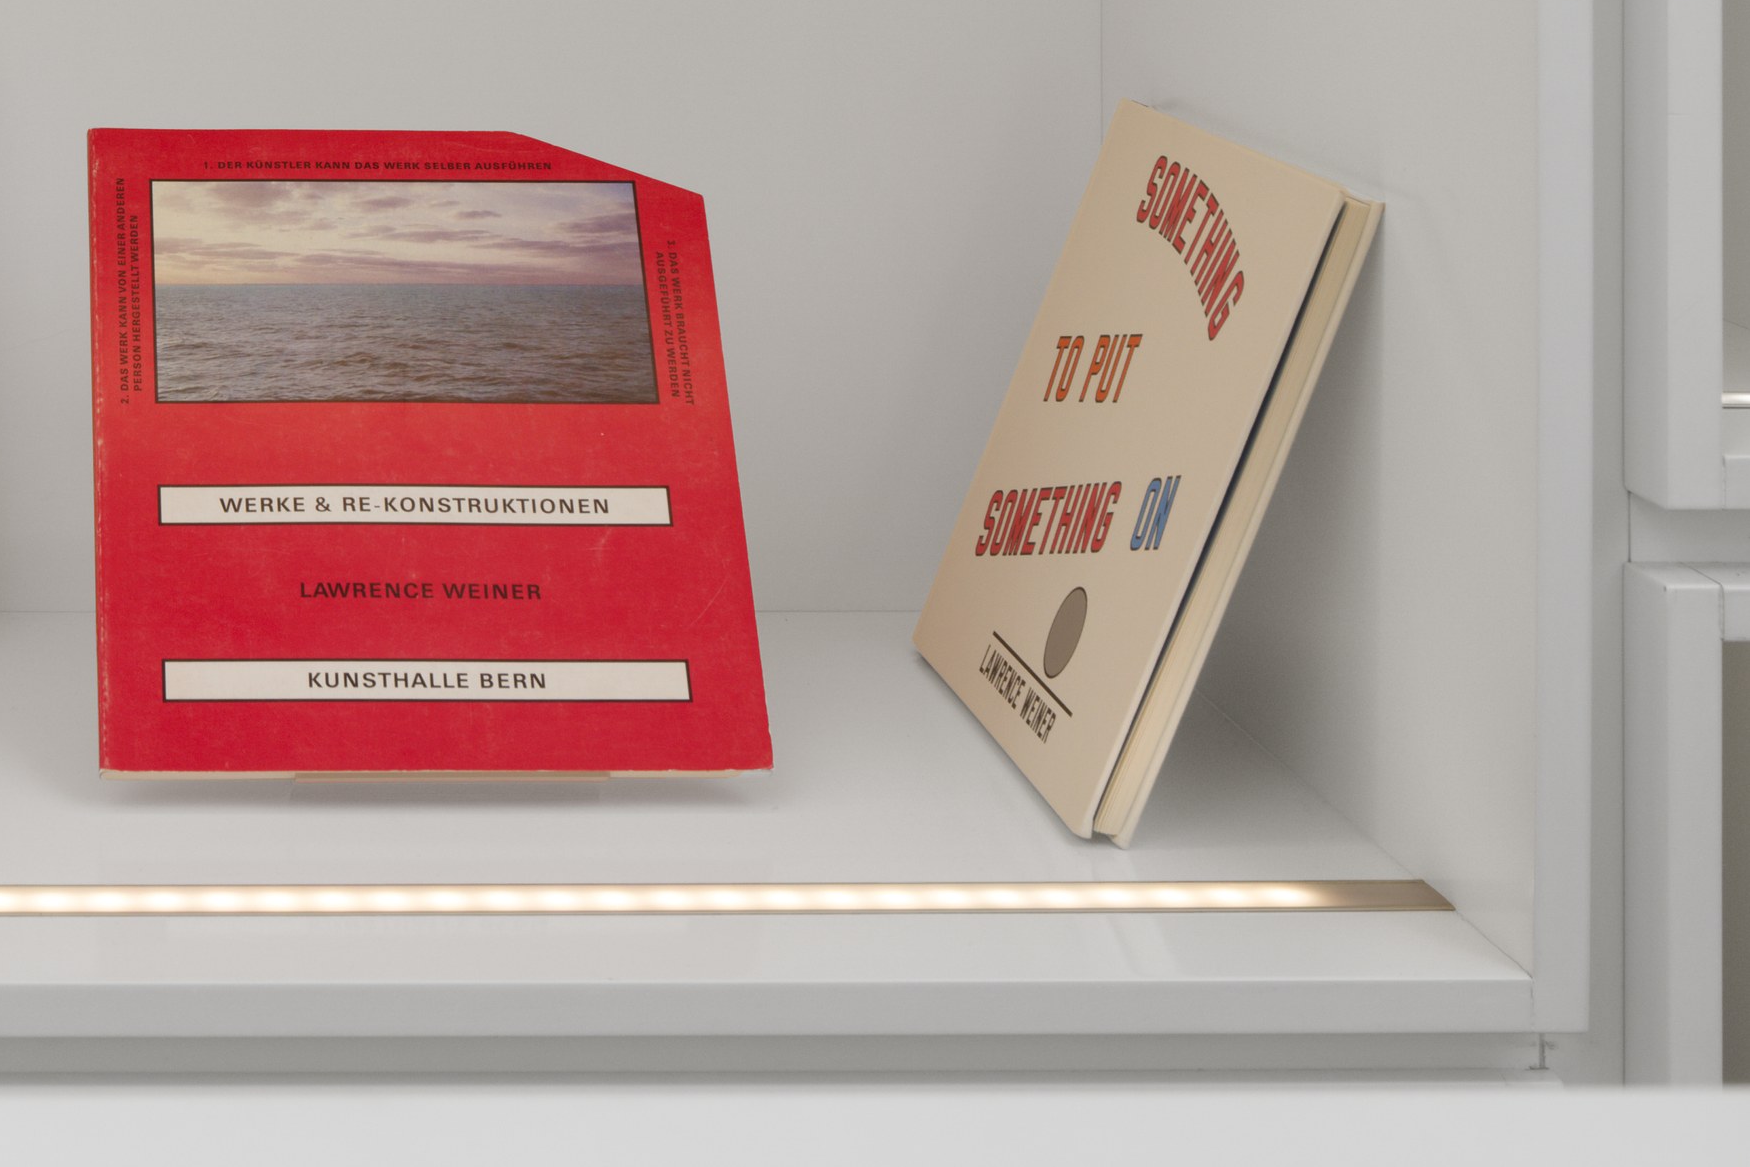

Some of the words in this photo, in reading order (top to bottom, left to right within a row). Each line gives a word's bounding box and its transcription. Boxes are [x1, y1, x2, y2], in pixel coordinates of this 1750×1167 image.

[217, 161, 242, 169] DER
[247, 160, 311, 169] KÜNSTLER
[315, 161, 350, 170] KANN
[354, 161, 380, 170] DAS
[383, 162, 420, 170] WERK
[424, 162, 471, 170] SELBER
[475, 160, 552, 170] AUSFÜHREN
[116, 178, 125, 230] ANDEREN
[117, 233, 126, 266] EINER
[130, 214, 139, 264] WERDEN
[1136, 155, 1245, 341] SOMETHING
[668, 252, 680, 275] DAS
[118, 270, 127, 296] VON
[656, 252, 672, 326] AUSGEFÜHRT
[671, 277, 683, 310] WERK
[119, 298, 127, 328] KANN
[131, 266, 141, 344] HERGESTELLT
[120, 332, 129, 370] WERK
[664, 330, 674, 345] ZU
[676, 313, 690, 366] BRAUCHT
[121, 372, 129, 391] DAS
[132, 348, 142, 391] PERSON
[667, 347, 680, 398] WERDEN
[1043, 334, 1086, 403] TO
[1078, 333, 1143, 403] PUT
[681, 370, 694, 405] NICHT
[219, 497, 305, 514] WERKE
[315, 497, 331, 513] &
[342, 496, 610, 515] RE-KONSTRUKTIONEN
[975, 480, 1122, 556] SOMETHING
[1129, 475, 1181, 551] ON
[300, 582, 434, 599] LAWRENCE
[442, 583, 542, 600] WEINER
[308, 672, 469, 689] KUNSTHALLE
[480, 673, 547, 689] BERN
[979, 644, 1026, 709] LAWRENCE
[1020, 686, 1057, 744] WEINER
